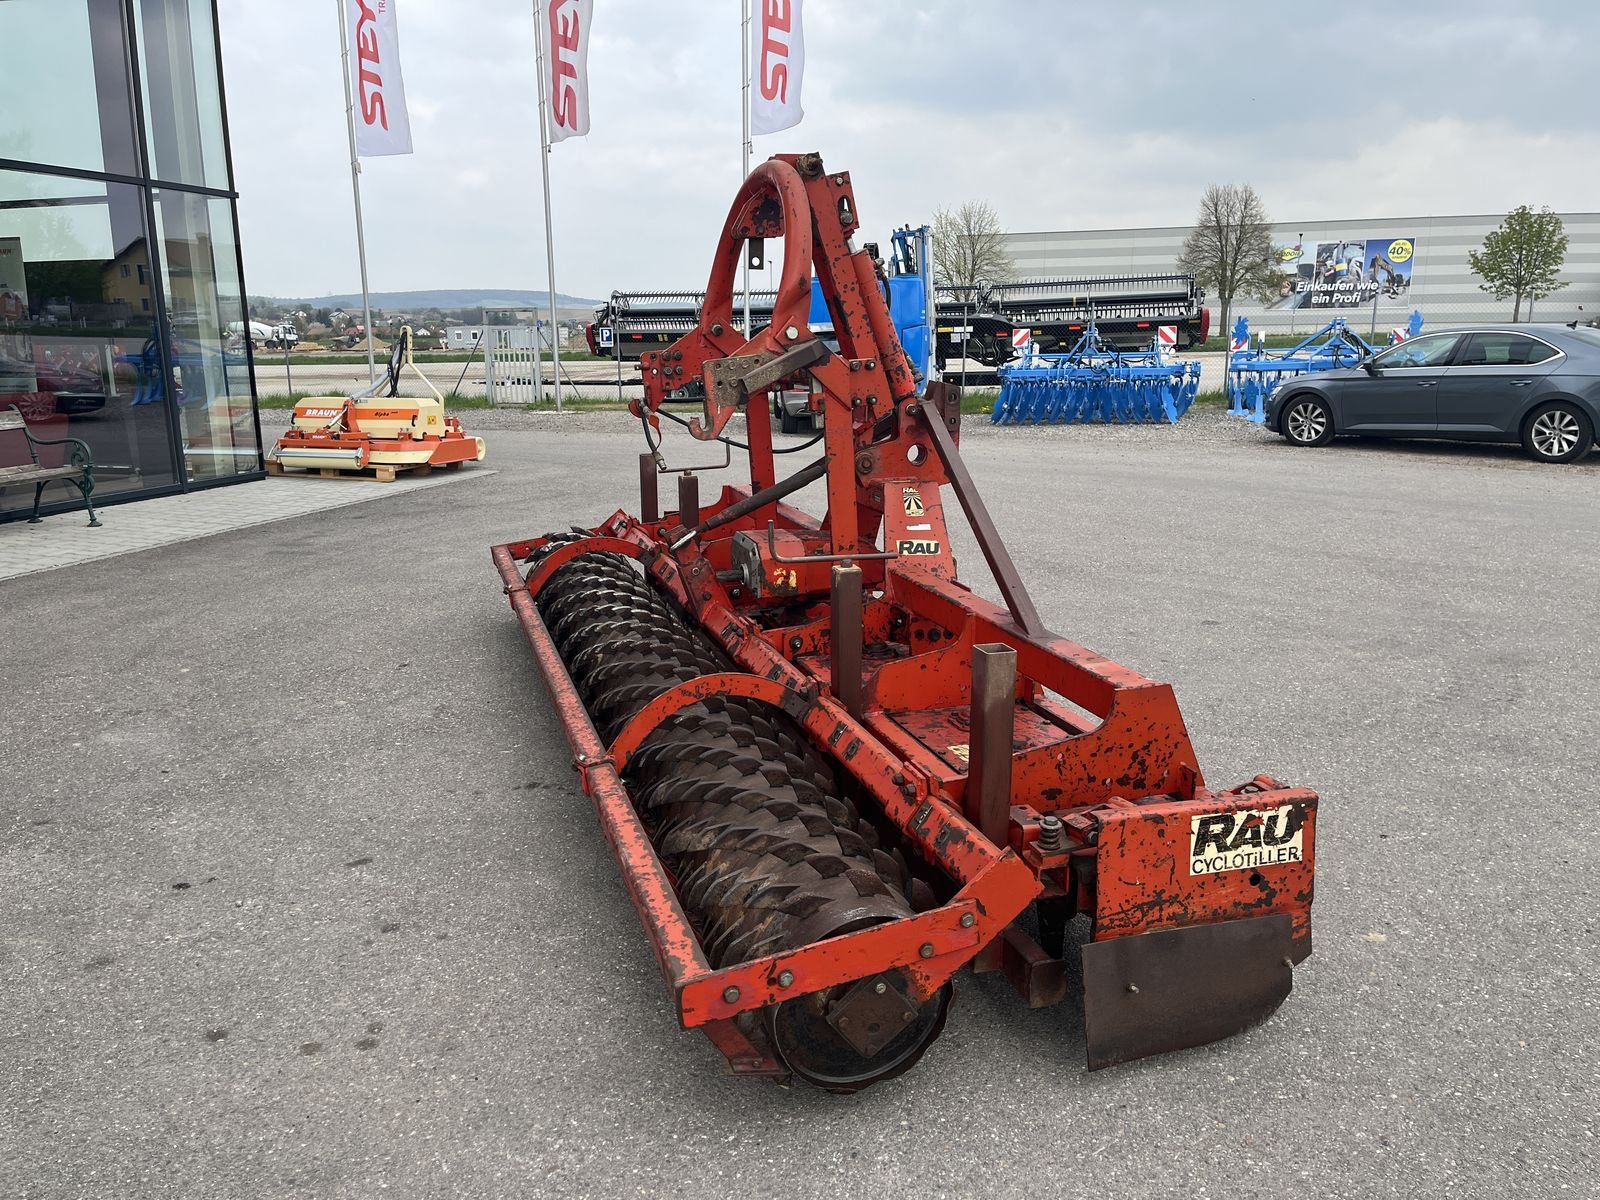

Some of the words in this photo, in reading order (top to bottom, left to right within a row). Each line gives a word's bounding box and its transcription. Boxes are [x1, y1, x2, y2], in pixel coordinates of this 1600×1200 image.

[1389, 246, 1411, 255] 40%
[1296, 280, 1354, 292] Einkaufen
[1356, 279, 1379, 291] wie
[1311, 294, 1330, 304] ein
[1331, 292, 1361, 303] Profi
[602, 329, 610, 341] P
[899, 541, 940, 554] RAU
[1192, 806, 1304, 856] RAU
